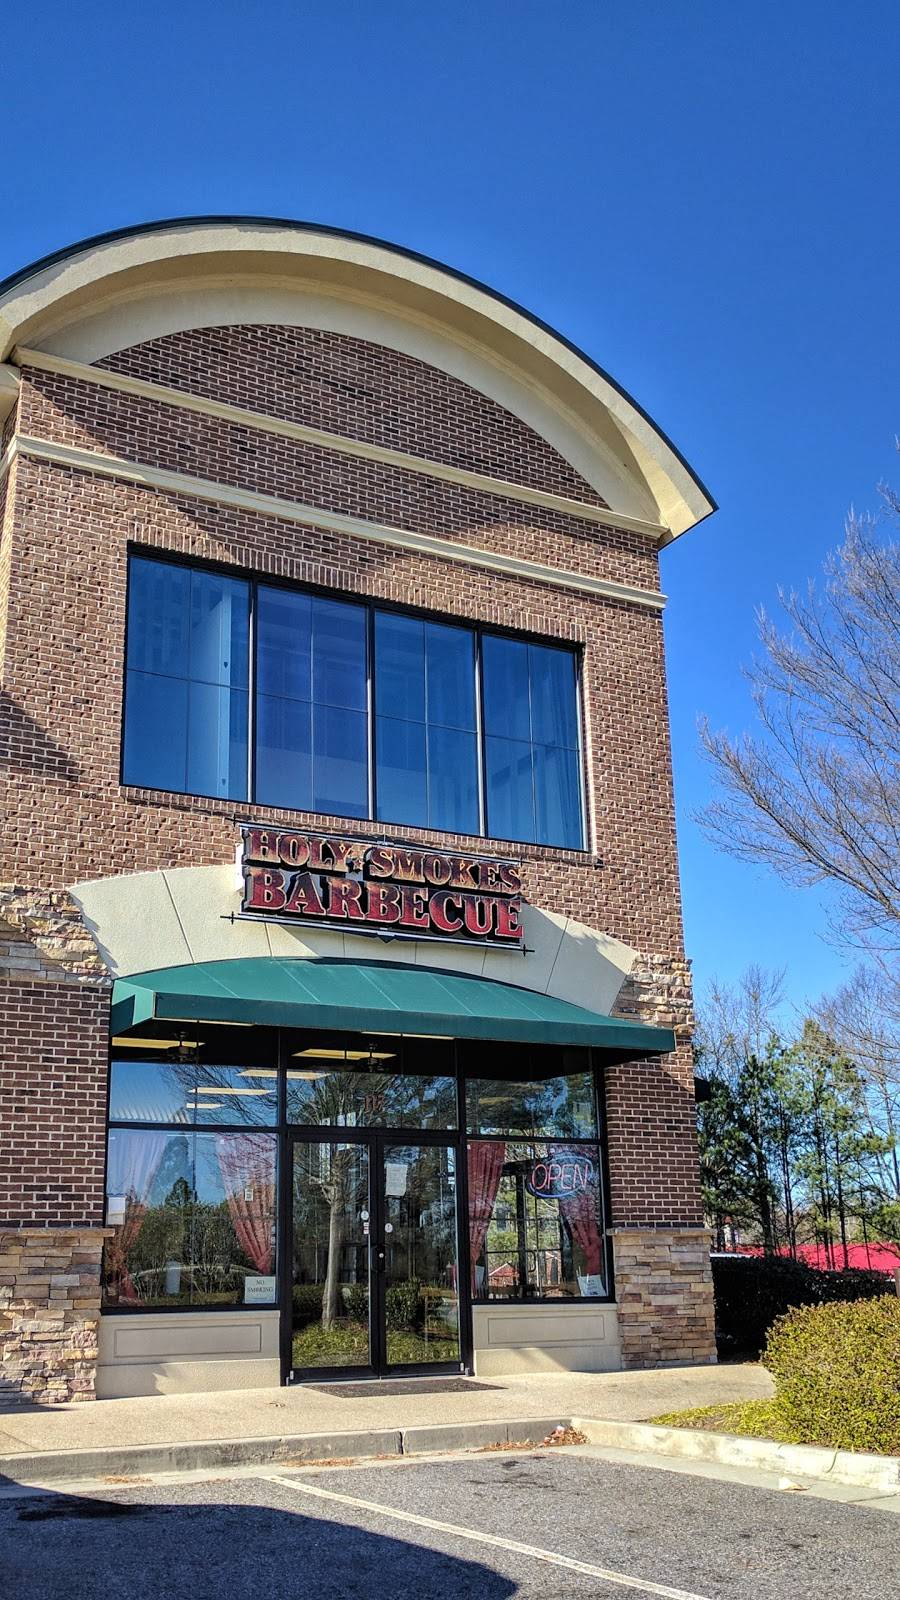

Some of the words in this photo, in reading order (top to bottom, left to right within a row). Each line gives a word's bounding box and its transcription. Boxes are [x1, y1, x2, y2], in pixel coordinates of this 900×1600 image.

[248, 828, 353, 873] HOLY
[369, 847, 522, 895] SMOKES
[248, 866, 524, 939] BARBECUE
[531, 1163, 589, 1190] OPEN
